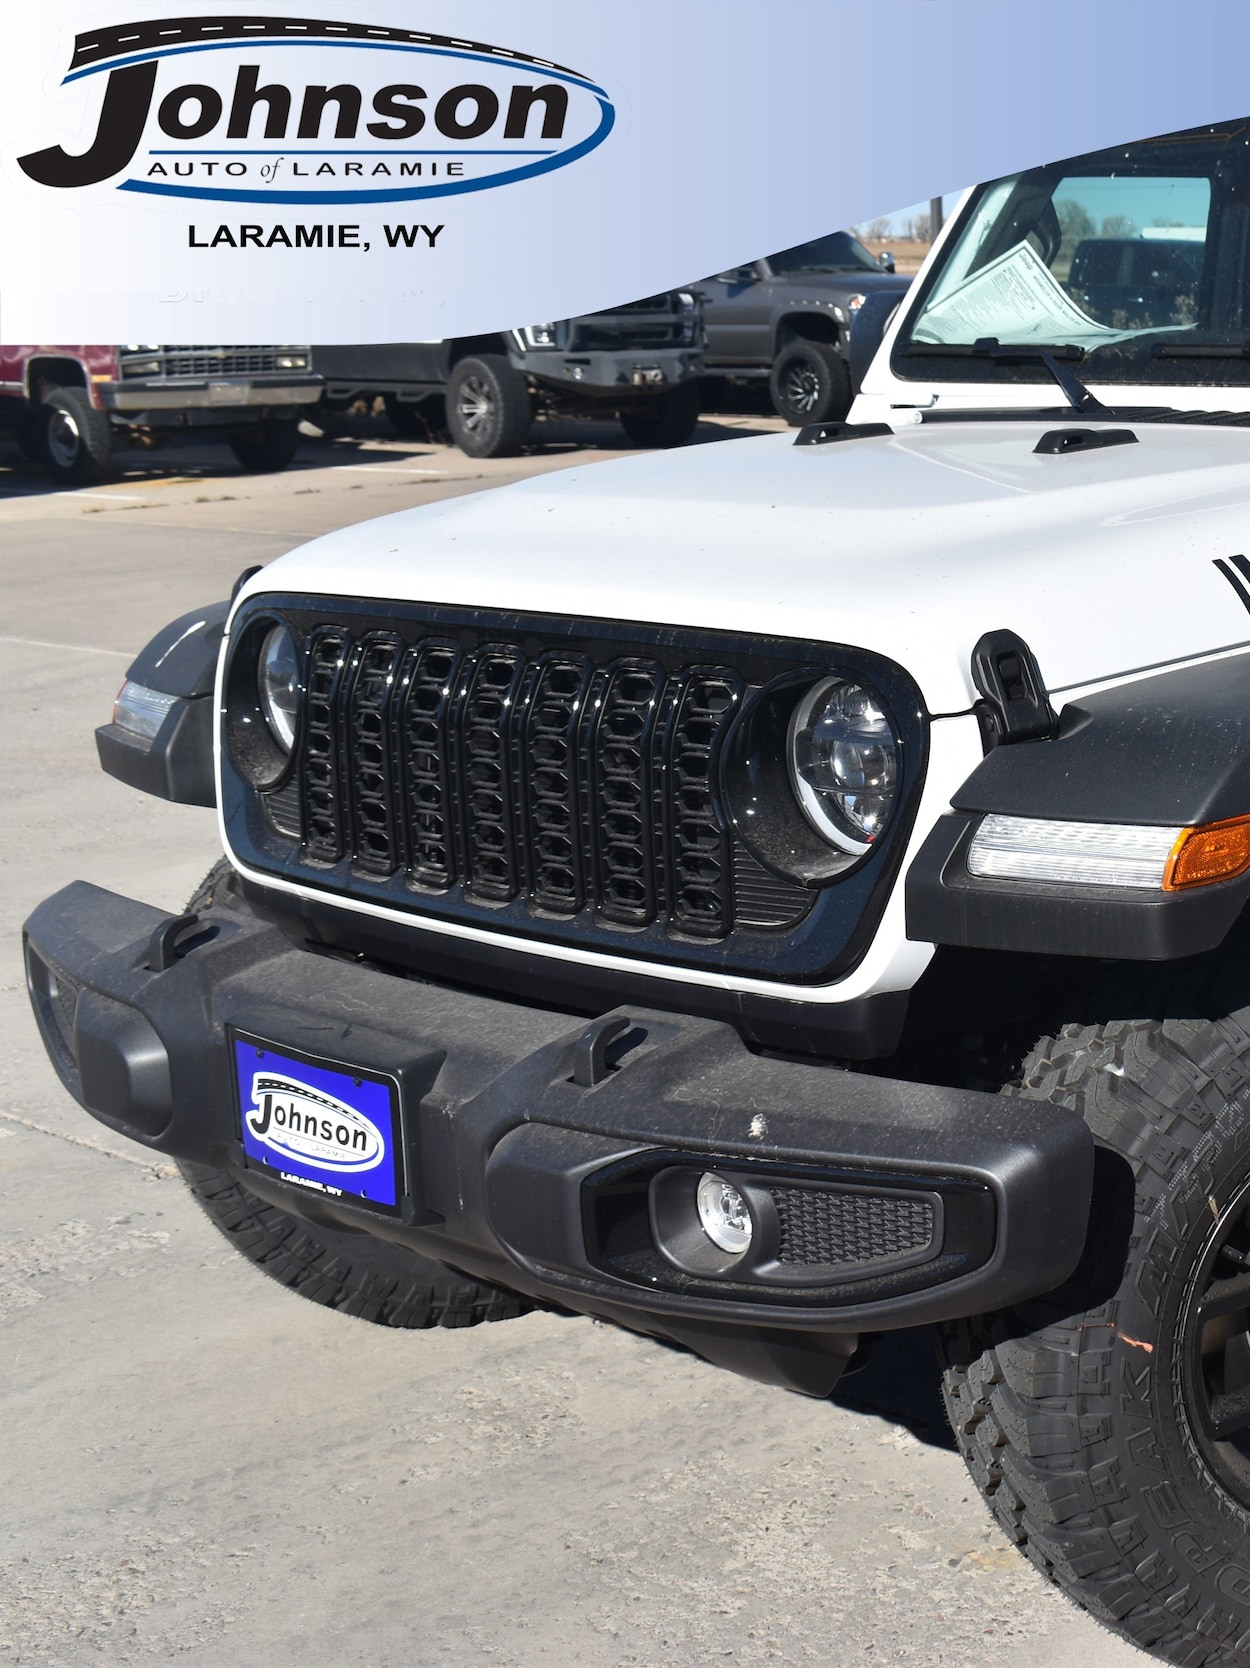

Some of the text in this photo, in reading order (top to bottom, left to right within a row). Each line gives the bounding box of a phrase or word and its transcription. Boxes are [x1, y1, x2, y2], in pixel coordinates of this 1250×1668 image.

[250, 1094, 367, 1151] Johnson
[281, 1172, 343, 1196] LARAMIE, WY
